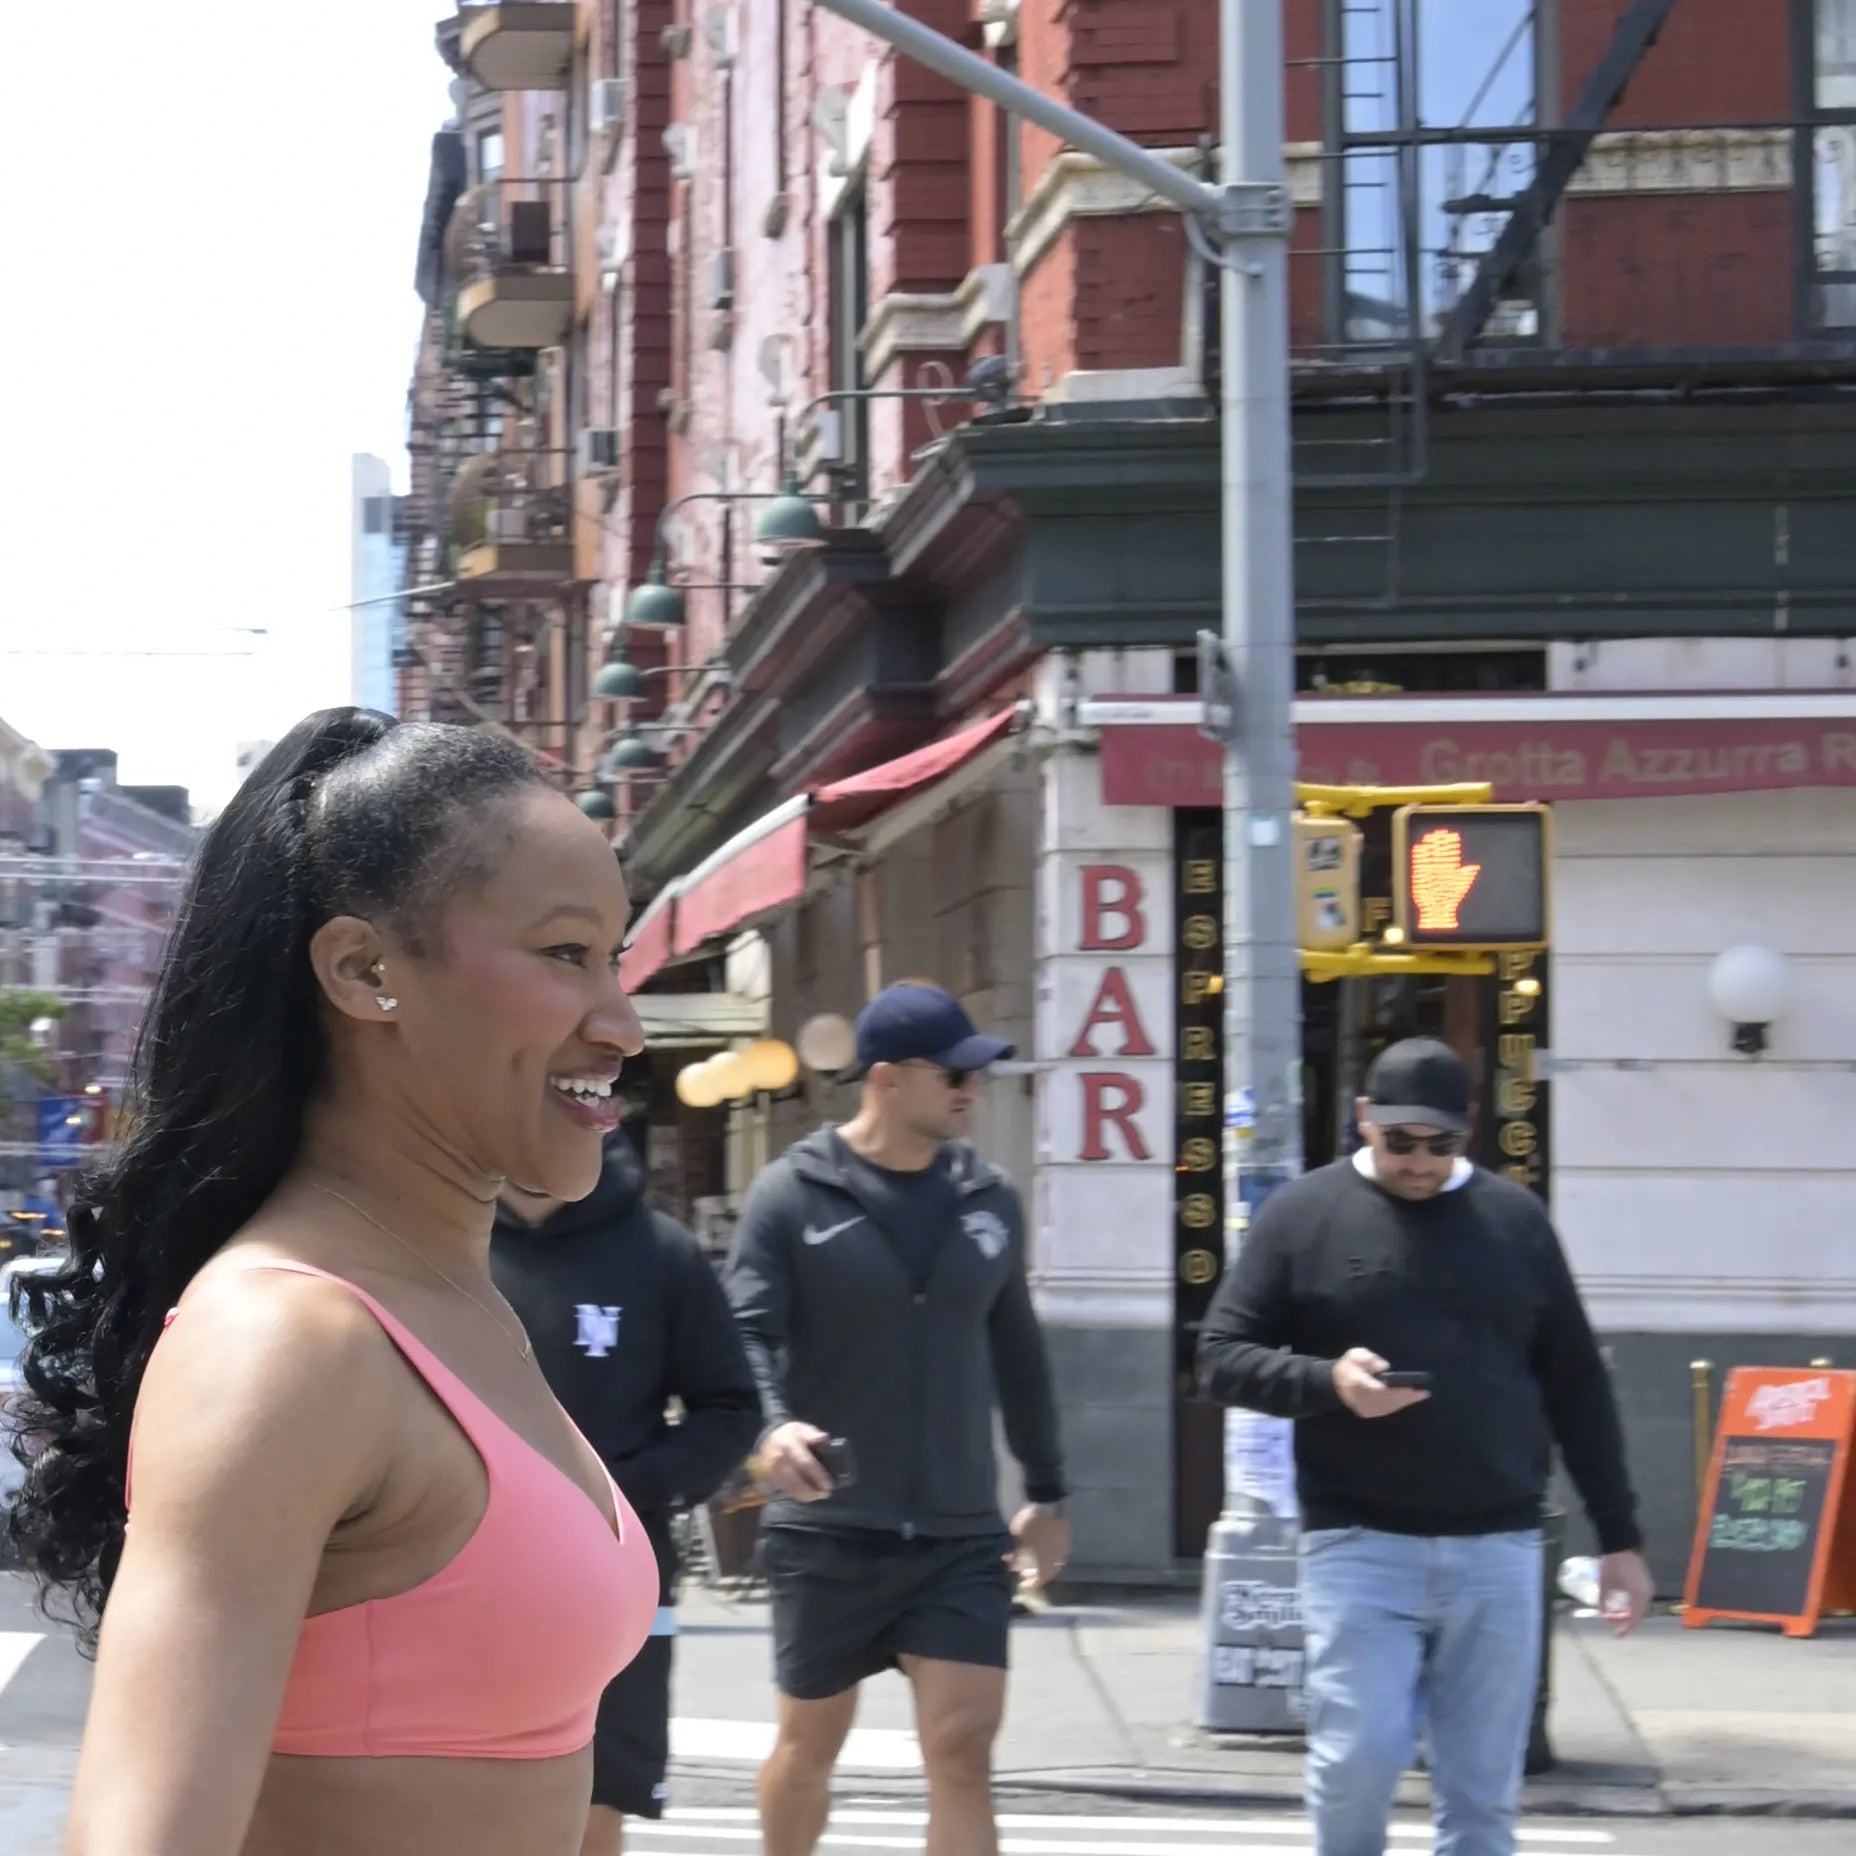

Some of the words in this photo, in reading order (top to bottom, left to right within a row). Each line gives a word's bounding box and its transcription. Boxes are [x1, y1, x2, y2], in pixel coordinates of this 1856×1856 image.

[1419, 738, 1586, 785] Grotta
[1598, 737, 1806, 783] Azzurra
[1069, 864, 1157, 1161] BAR
[1181, 859, 1218, 1285] ESPRESSO
